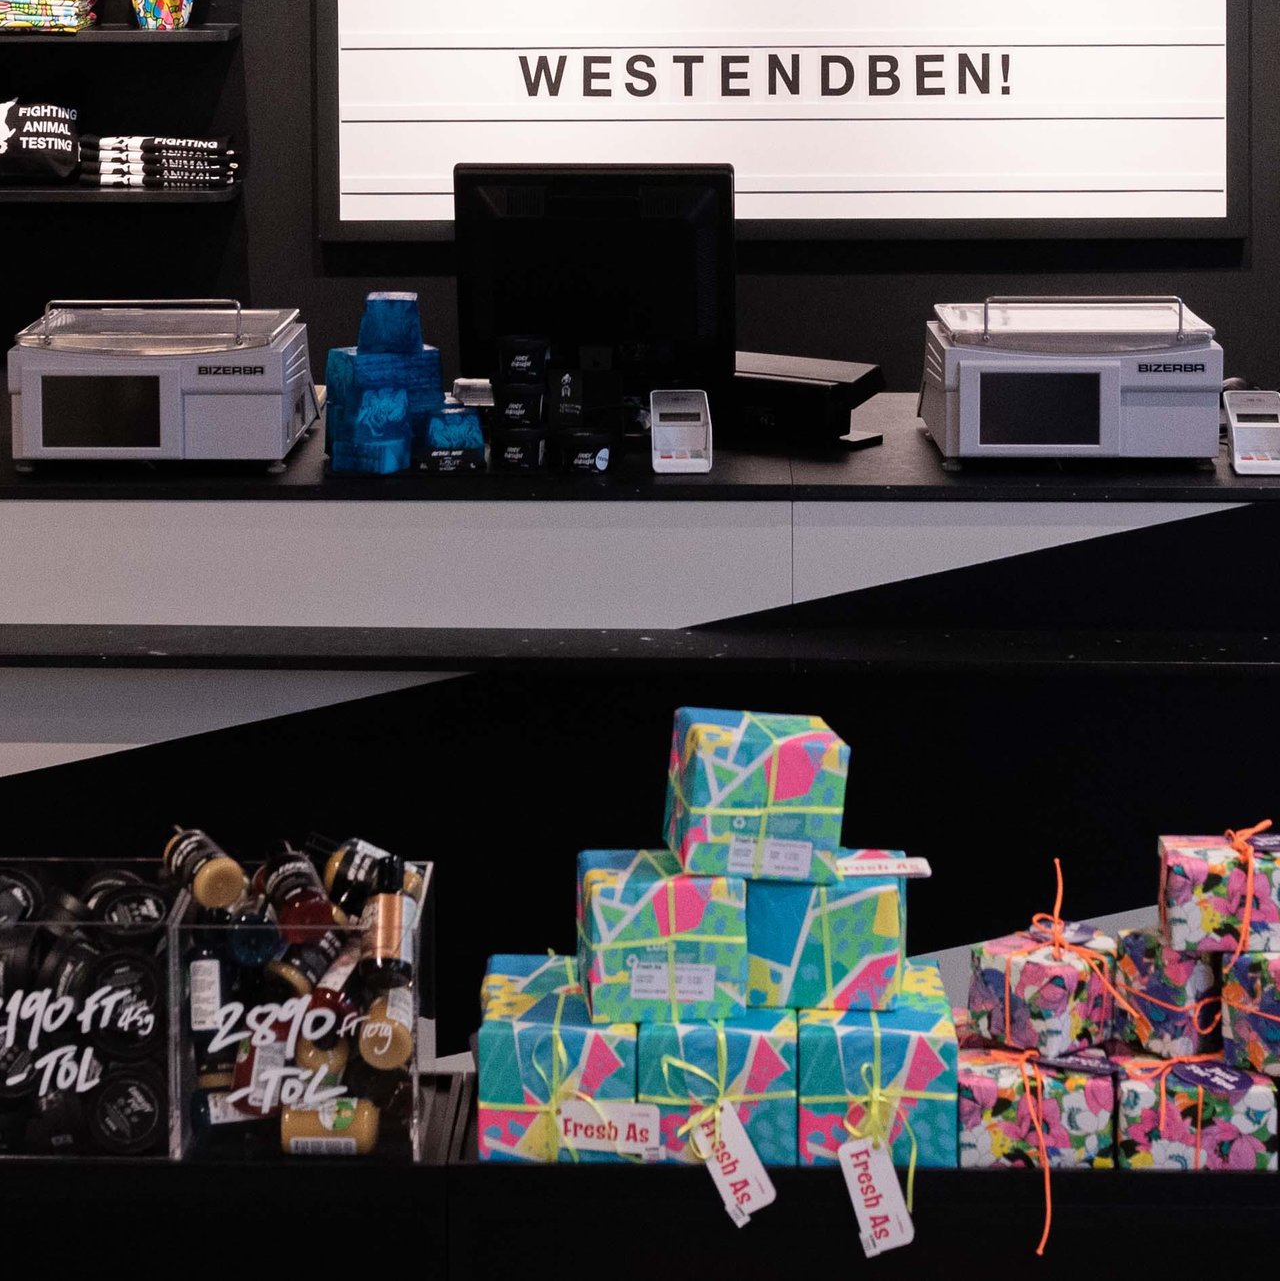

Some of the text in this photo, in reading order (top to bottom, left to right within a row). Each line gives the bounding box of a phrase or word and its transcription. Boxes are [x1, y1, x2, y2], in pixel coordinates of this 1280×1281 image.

[518, 52, 1012, 97] WESTENDBEN!
[18, 106, 78, 121] FIGHTING
[22, 120, 72, 136] ANIMAL
[20, 136, 73, 152] TESTING
[153, 137, 218, 149] FIGHTING
[198, 365, 265, 376] BIZERBA
[1138, 363, 1207, 373] BIZERBA
[207, 993, 338, 1060] 2890
[561, 1118, 651, 1143] Fresh As
[719, 1177, 753, 1207] As
[849, 1148, 891, 1242] Fresh As
